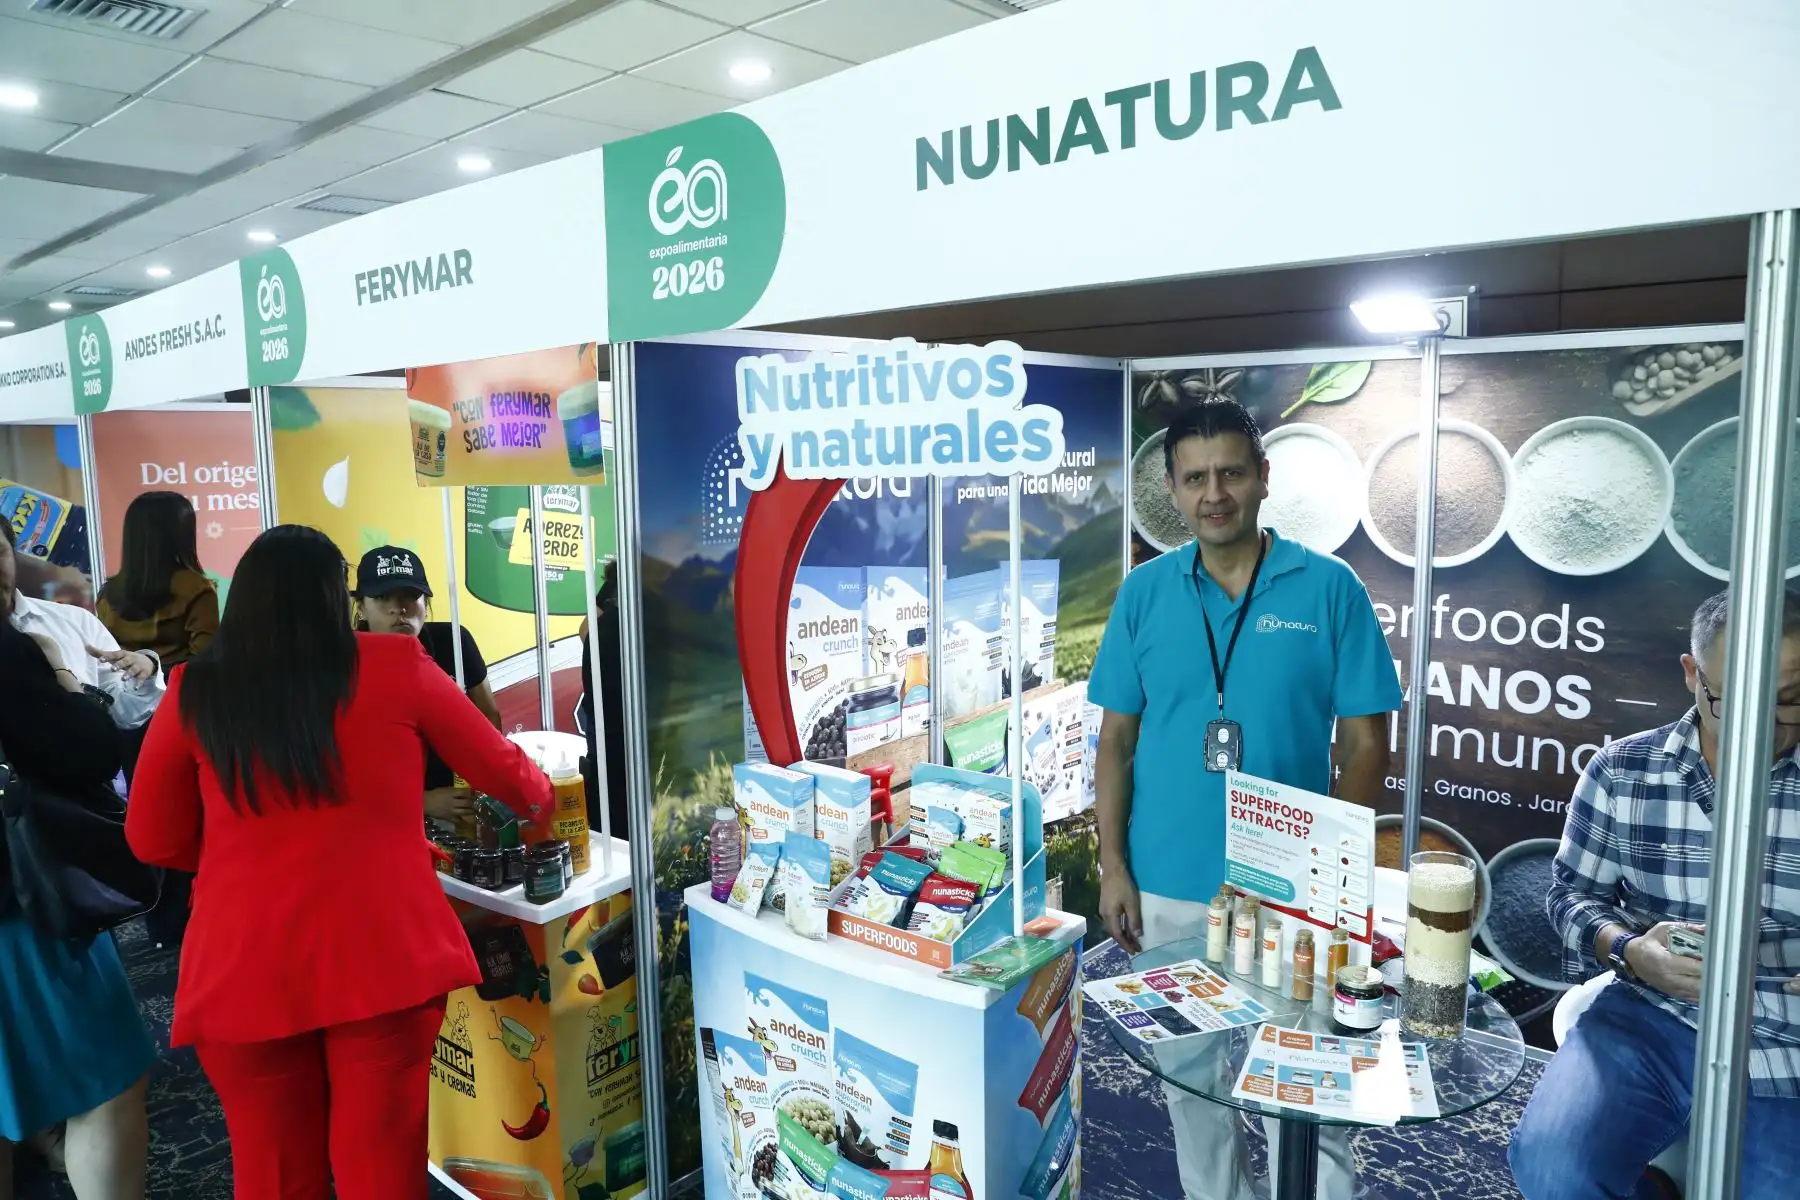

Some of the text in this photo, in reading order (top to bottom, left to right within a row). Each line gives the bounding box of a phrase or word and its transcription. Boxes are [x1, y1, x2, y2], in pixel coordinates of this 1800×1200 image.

[914, 45, 1343, 191] NUNATURA
[649, 232, 728, 260] expoalimentaria
[354, 248, 474, 306] FERYMAR
[652, 256, 725, 300] 2026
[125, 313, 226, 361] ANDES FRESH S.A.C.
[262, 336, 289, 362] 2026
[12, 364, 55, 386] CORPORATION
[55, 361, 67, 378] S.A.
[83, 378, 102, 396] 2026
[744, 350, 1014, 414] Nutritivos
[746, 408, 1053, 479] y naturales
[140, 460, 257, 488] Del orige
[957, 486, 985, 505] para
[987, 485, 1009, 497] una
[1052, 470, 1093, 498] Mejor
[797, 614, 859, 640] andean
[1263, 617, 1318, 633] nunatura
[822, 635, 859, 653] crunch
[1393, 659, 1592, 720] ANOS
[1230, 776, 1279, 798] Looking for
[1435, 779, 1512, 806] Granos
[750, 800, 790, 822] andean
[969, 807, 997, 820] andean
[1231, 790, 1314, 825] SUPERFOOD
[764, 816, 790, 830] crunch
[820, 817, 849, 831] crunch
[1231, 805, 1310, 840] EXTRACTS?
[1231, 822, 1244, 834] Ask
[932, 887, 976, 899] nunasticks
[841, 919, 918, 956] SUPERFOODS
[770, 1018, 826, 1050] andean
[791, 1042, 827, 1063] crunch
[1038, 1031, 1074, 1108] nunasticks
[733, 1075, 768, 1094] andean
[835, 1079, 873, 1106] andean
[834, 1096, 858, 1113] chocolate
[783, 1137, 827, 1175] nunasticks
